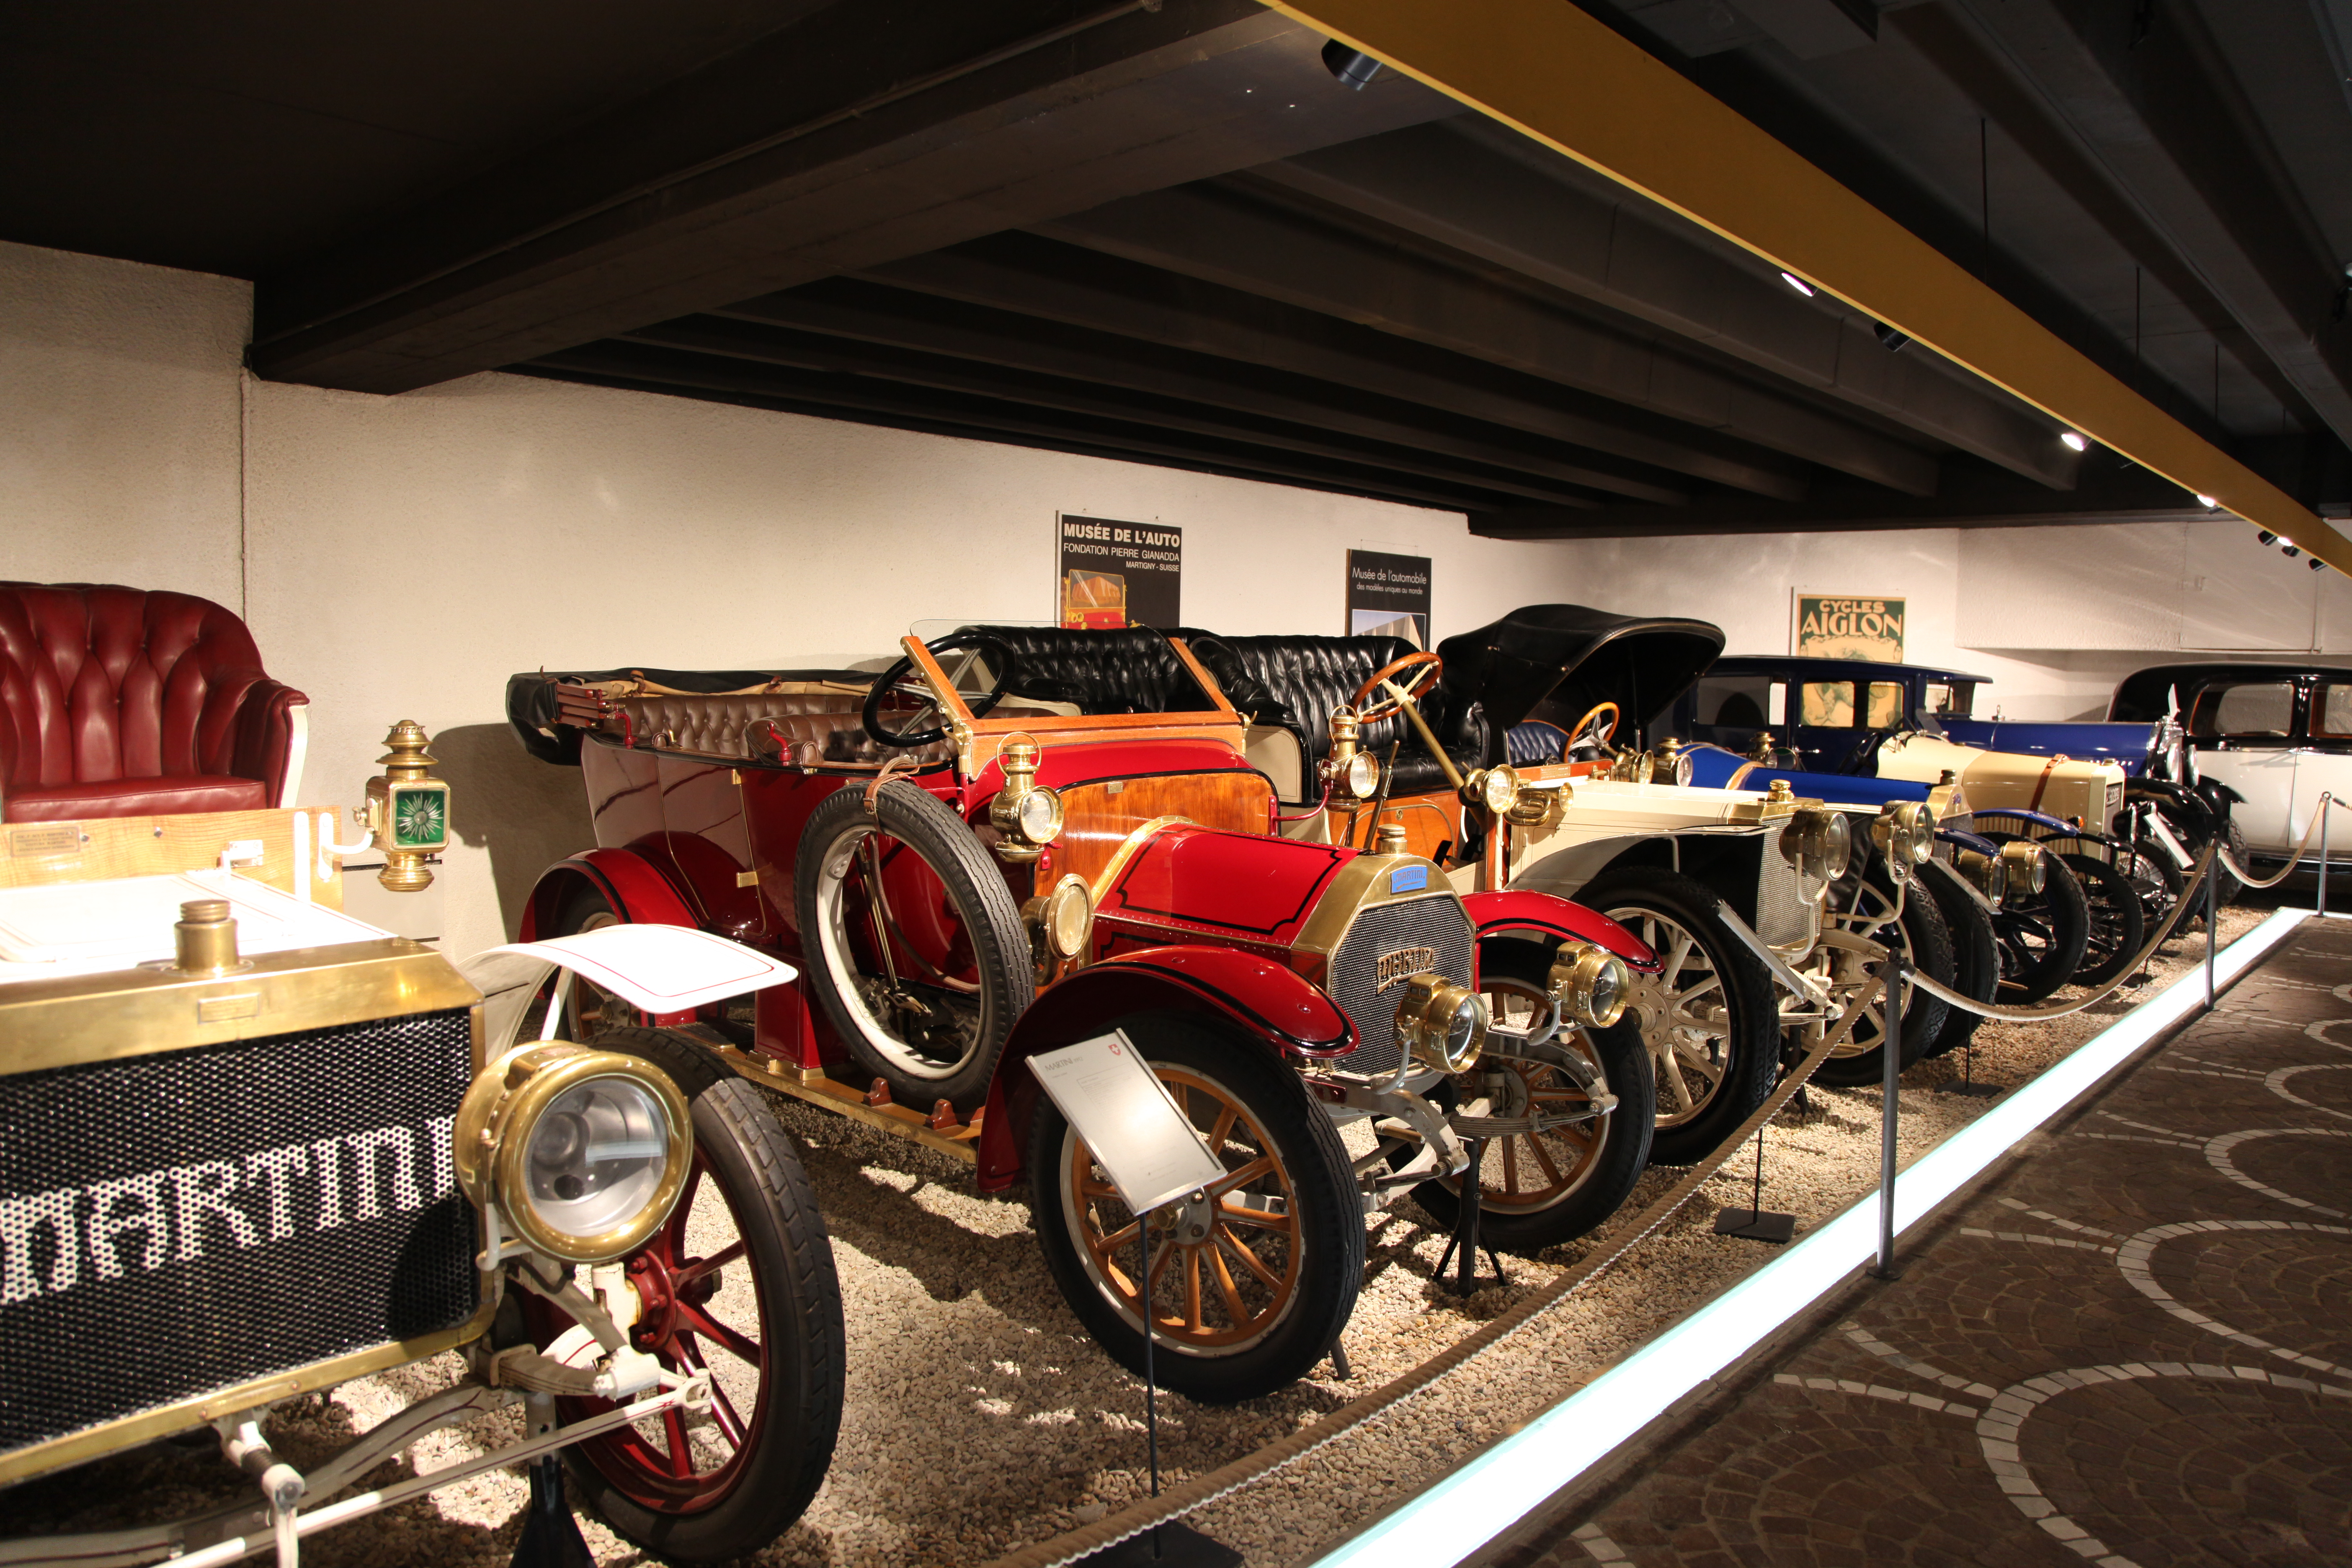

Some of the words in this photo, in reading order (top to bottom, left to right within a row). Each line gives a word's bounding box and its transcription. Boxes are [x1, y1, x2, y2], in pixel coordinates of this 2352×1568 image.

[1064, 523, 1110, 540] MUSÉE
[1114, 529, 1131, 542] DE
[1135, 531, 1180, 547] L'AUTO
[1064, 543, 1108, 555] FONDATION
[1112, 547, 1139, 558] PIERRE
[1142, 550, 1179, 561] GIANADDA
[1126, 561, 1155, 570] MARTIGNY
[1352, 567, 1375, 580] Musée
[1377, 569, 1386, 580] de
[1388, 570, 1426, 584] l'automobile
[1366, 583, 1384, 591] modèles
[1385, 586, 1401, 594] uniques
[1819, 600, 1885, 613] CYCLES
[1801, 611, 1902, 637] AIGLON
